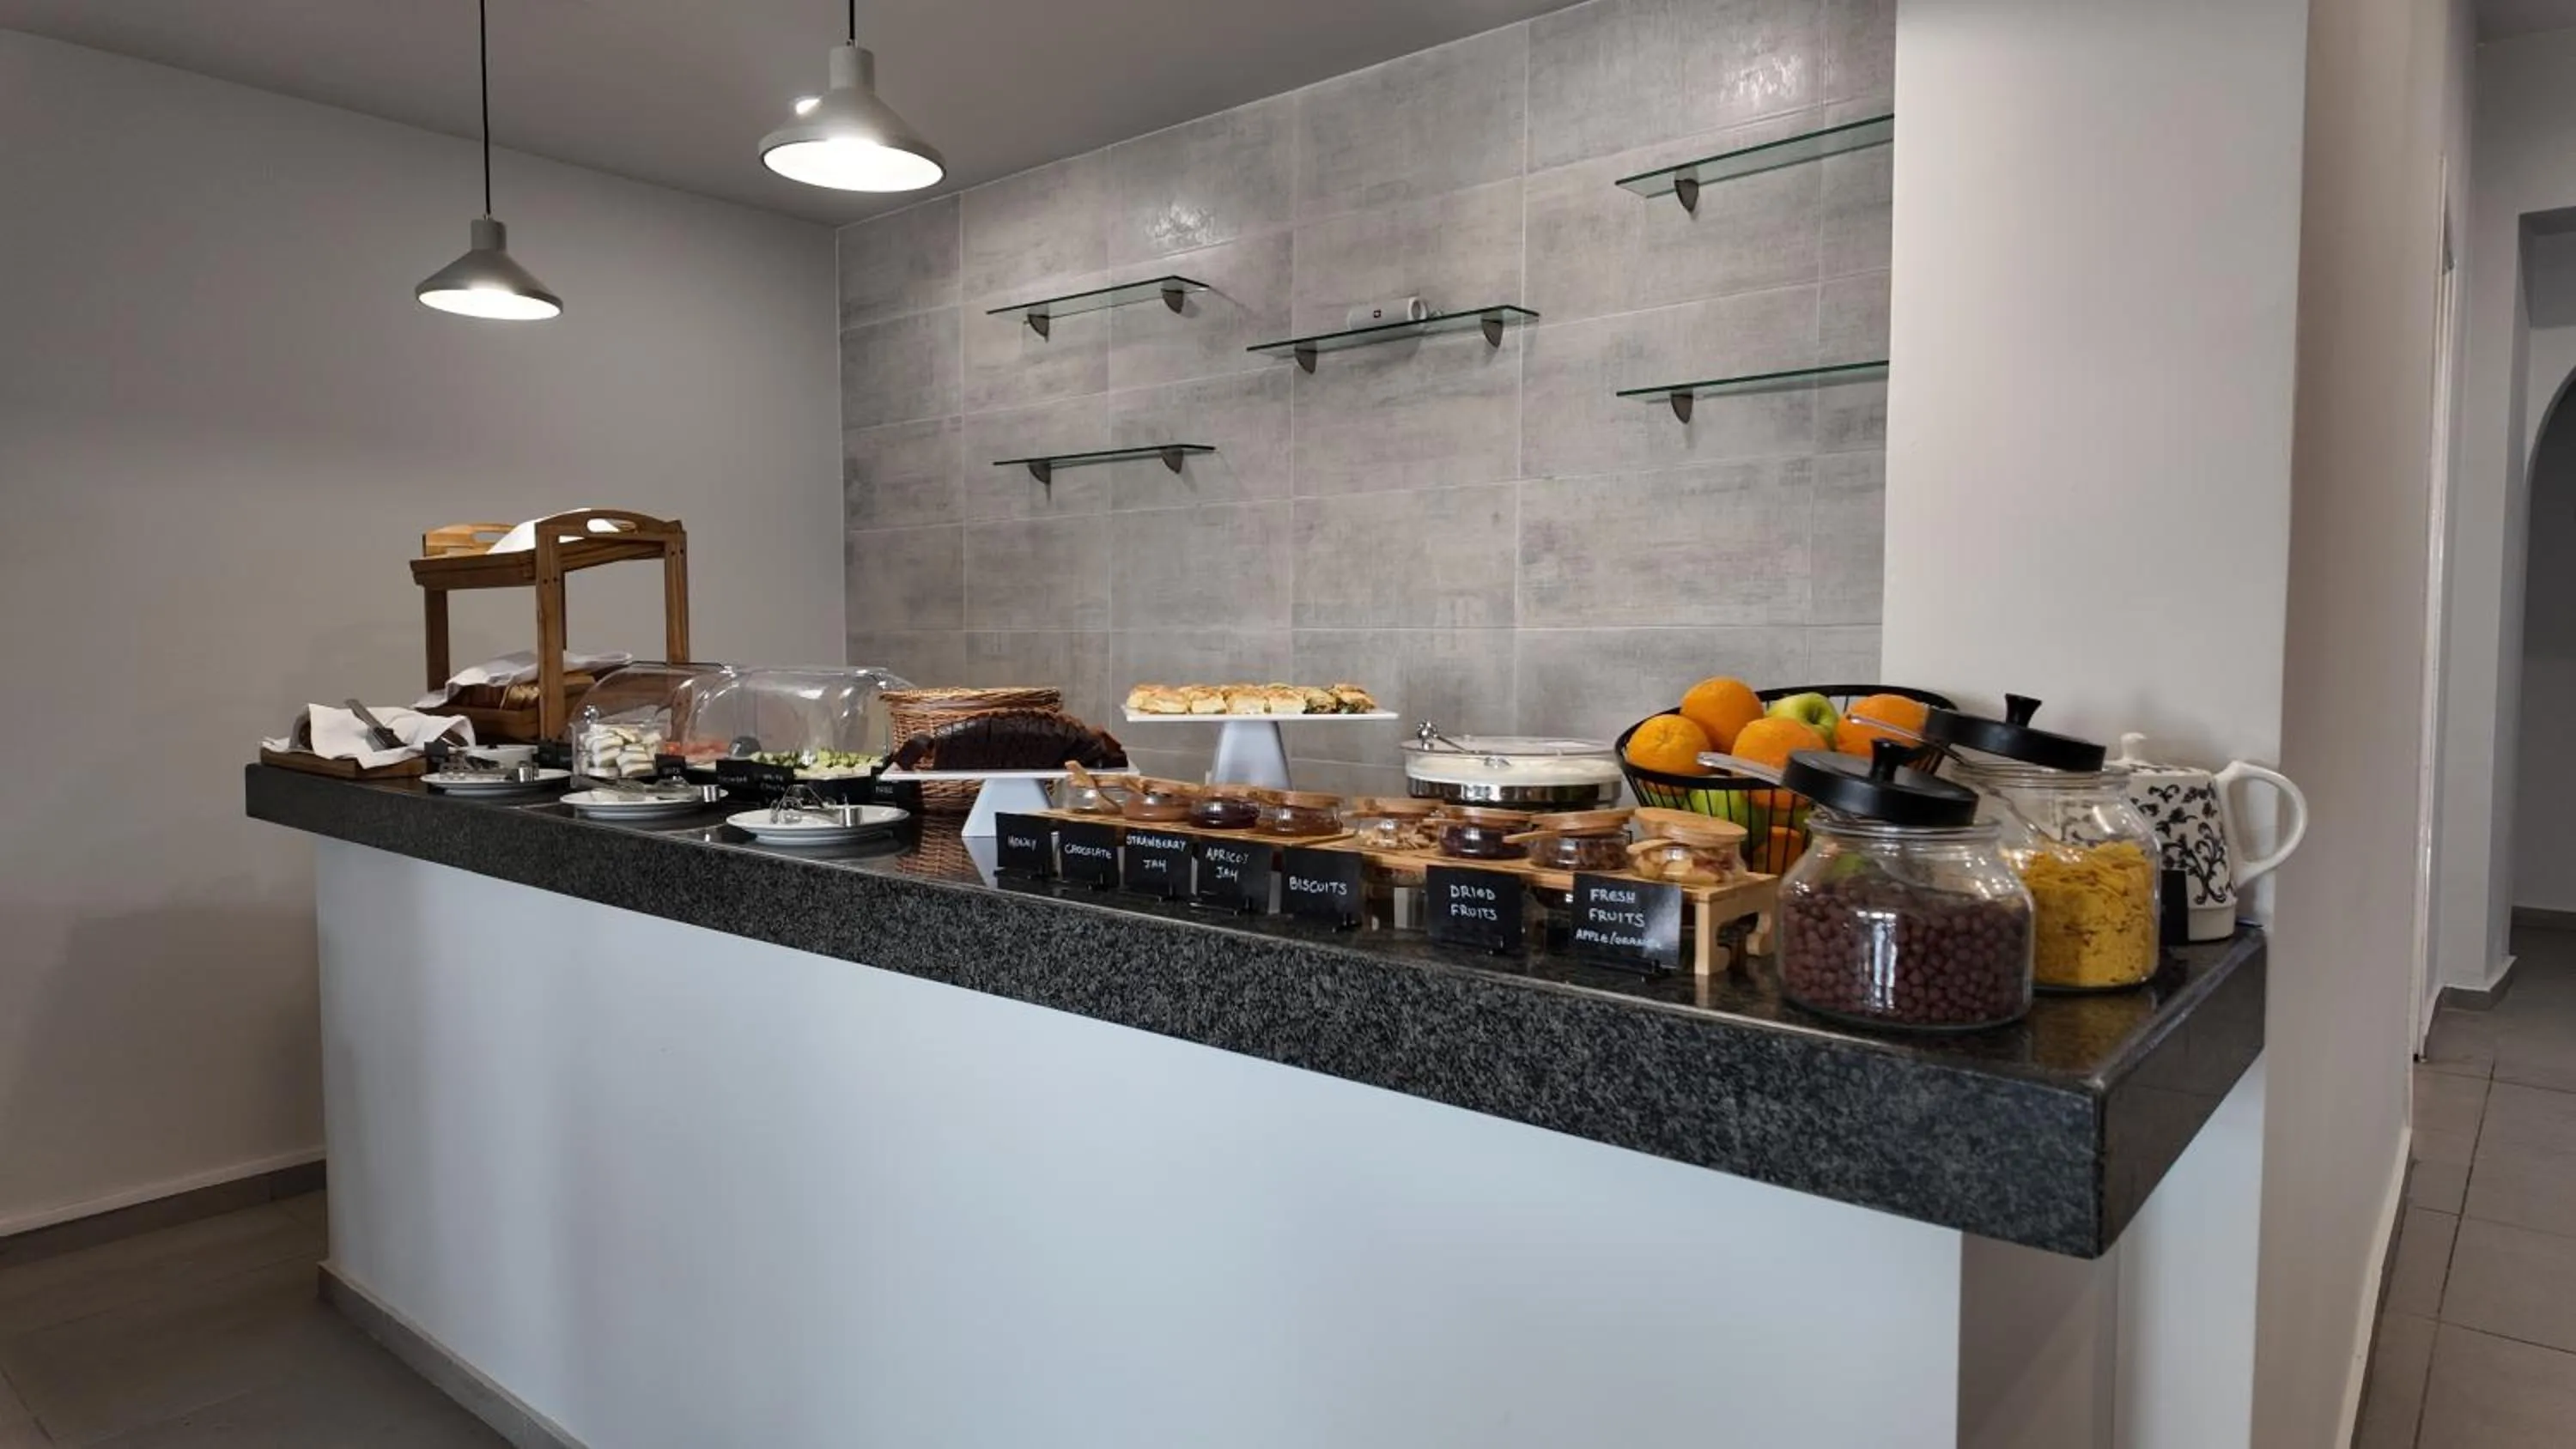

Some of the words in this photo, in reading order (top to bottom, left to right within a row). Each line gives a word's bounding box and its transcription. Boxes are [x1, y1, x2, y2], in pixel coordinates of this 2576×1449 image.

[1126, 835, 1187, 852] STRAWBERRY
[1206, 847, 1249, 864] APRICOT
[1143, 859, 1166, 872] JAM
[1216, 866, 1238, 882] JAM
[1289, 876, 1347, 895] BISCUITS
[1450, 904, 1498, 921] FRUITS
[1589, 907, 1645, 927] FRUITS
